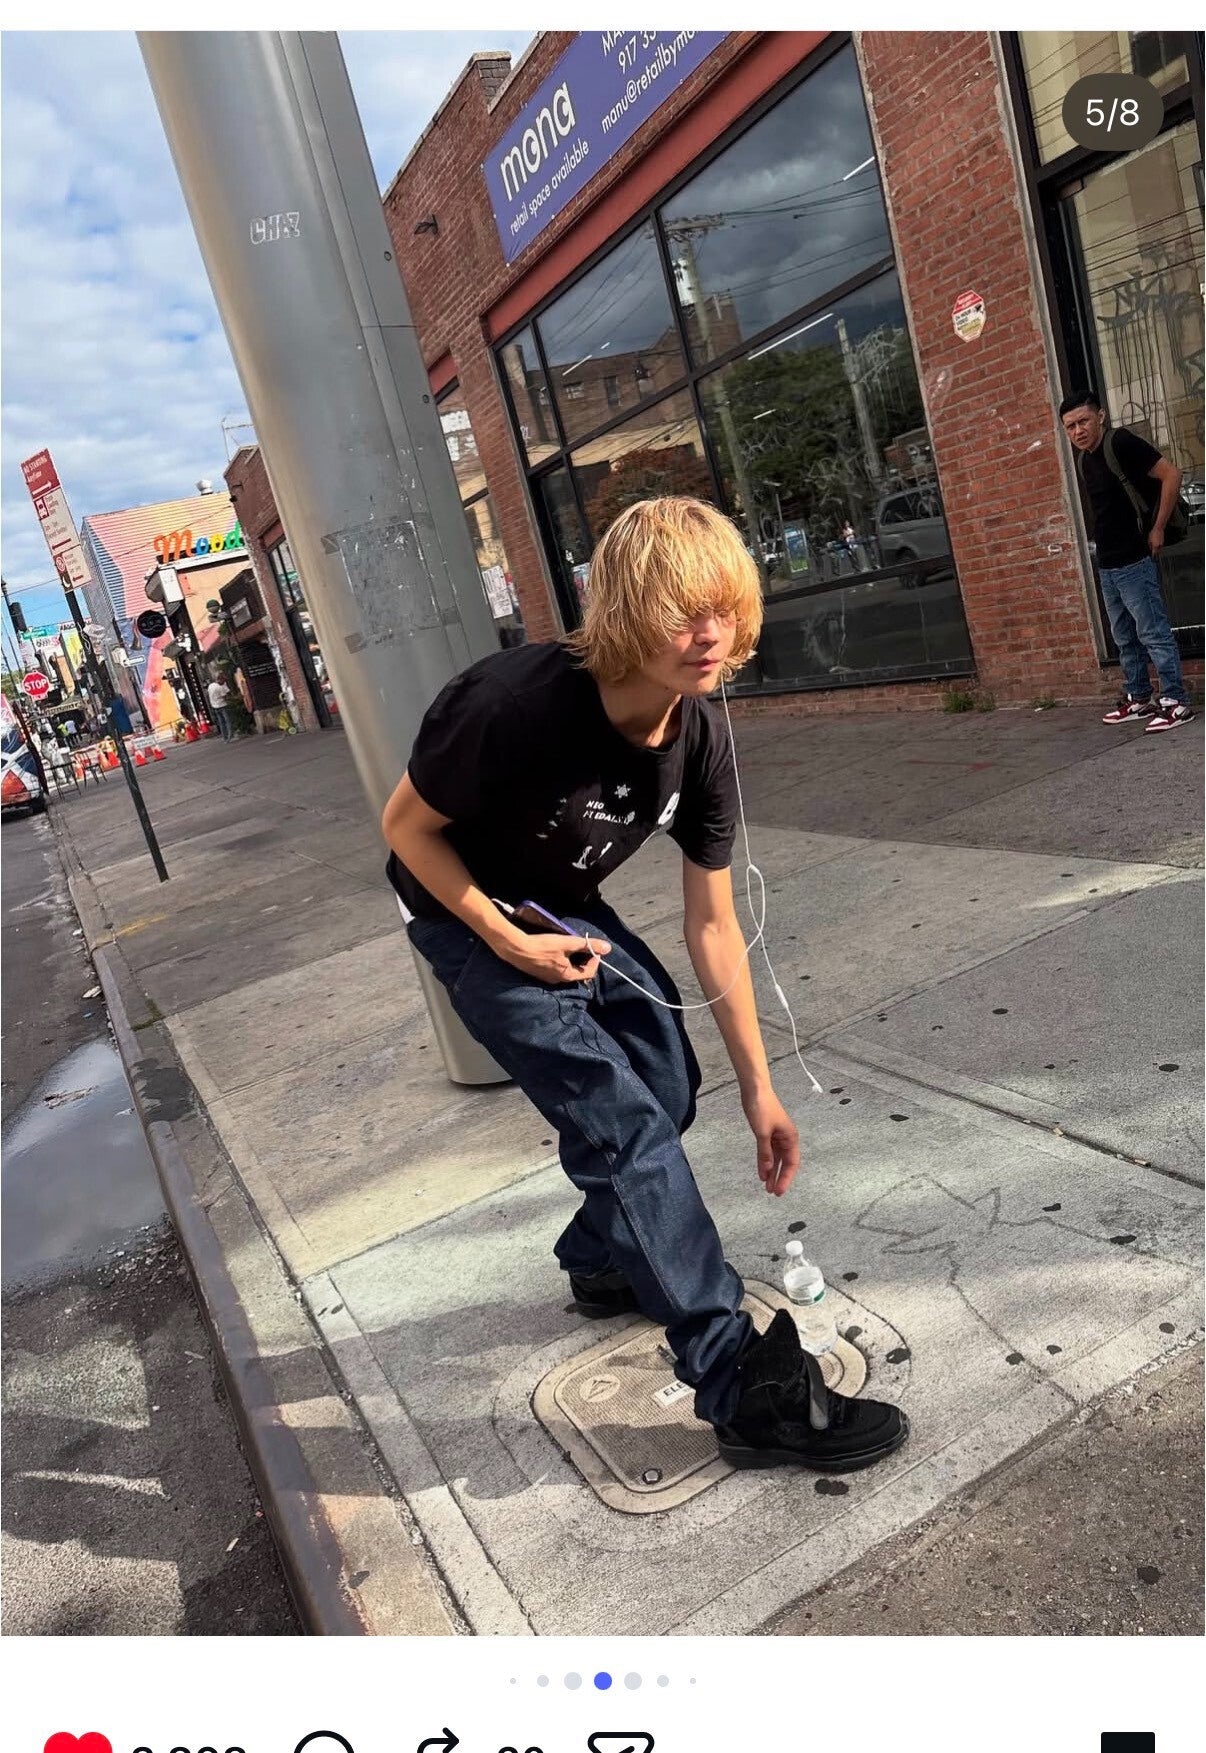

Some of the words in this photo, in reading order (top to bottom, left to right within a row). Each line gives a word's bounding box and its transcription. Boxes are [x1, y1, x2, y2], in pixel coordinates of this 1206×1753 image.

[601, 31, 625, 57] MA
[618, 35, 637, 74] 917
[500, 82, 576, 202] mona
[510, 202, 529, 237] retail
[528, 184, 551, 219] space
[551, 137, 589, 190] available
[153, 520, 242, 564] Mood
[23, 678, 47, 692] STOP
[586, 800, 604, 810] NEO
[663, 1381, 688, 1396] ELE
